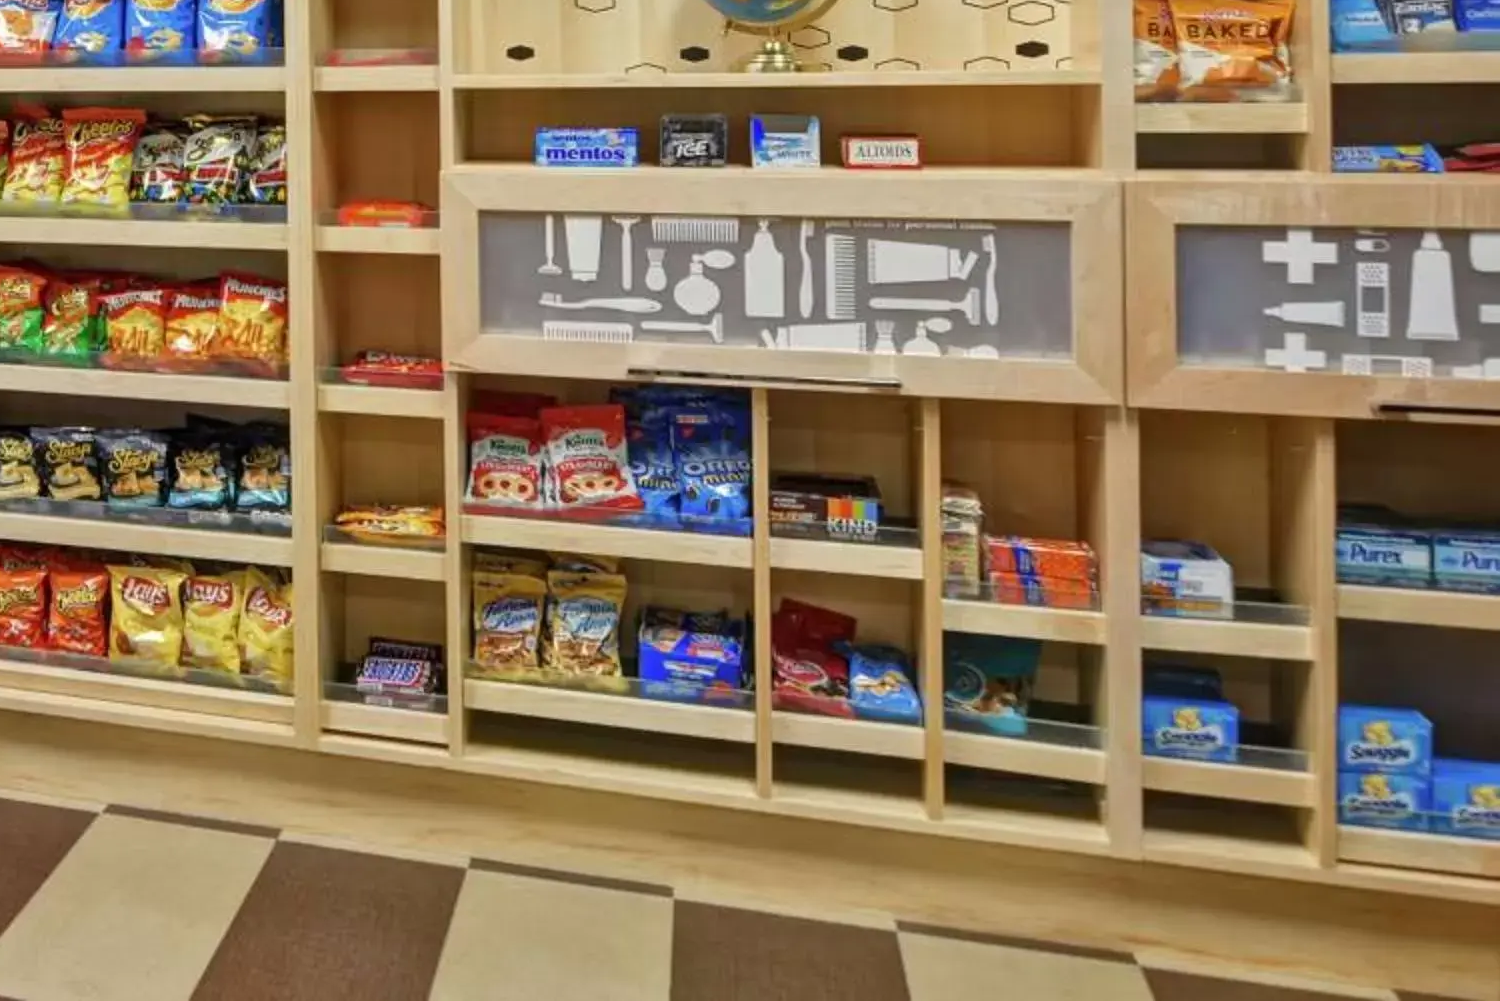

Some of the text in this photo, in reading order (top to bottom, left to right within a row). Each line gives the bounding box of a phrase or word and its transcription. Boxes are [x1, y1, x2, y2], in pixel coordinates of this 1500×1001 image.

[1186, 22, 1270, 40] BAKED
[546, 147, 626, 163] mentos
[674, 139, 709, 159] ICE
[856, 144, 913, 160] ALTOIDS
[683, 459, 750, 477] OREO
[826, 518, 879, 535] KIND
[1350, 543, 1404, 565] Purex
